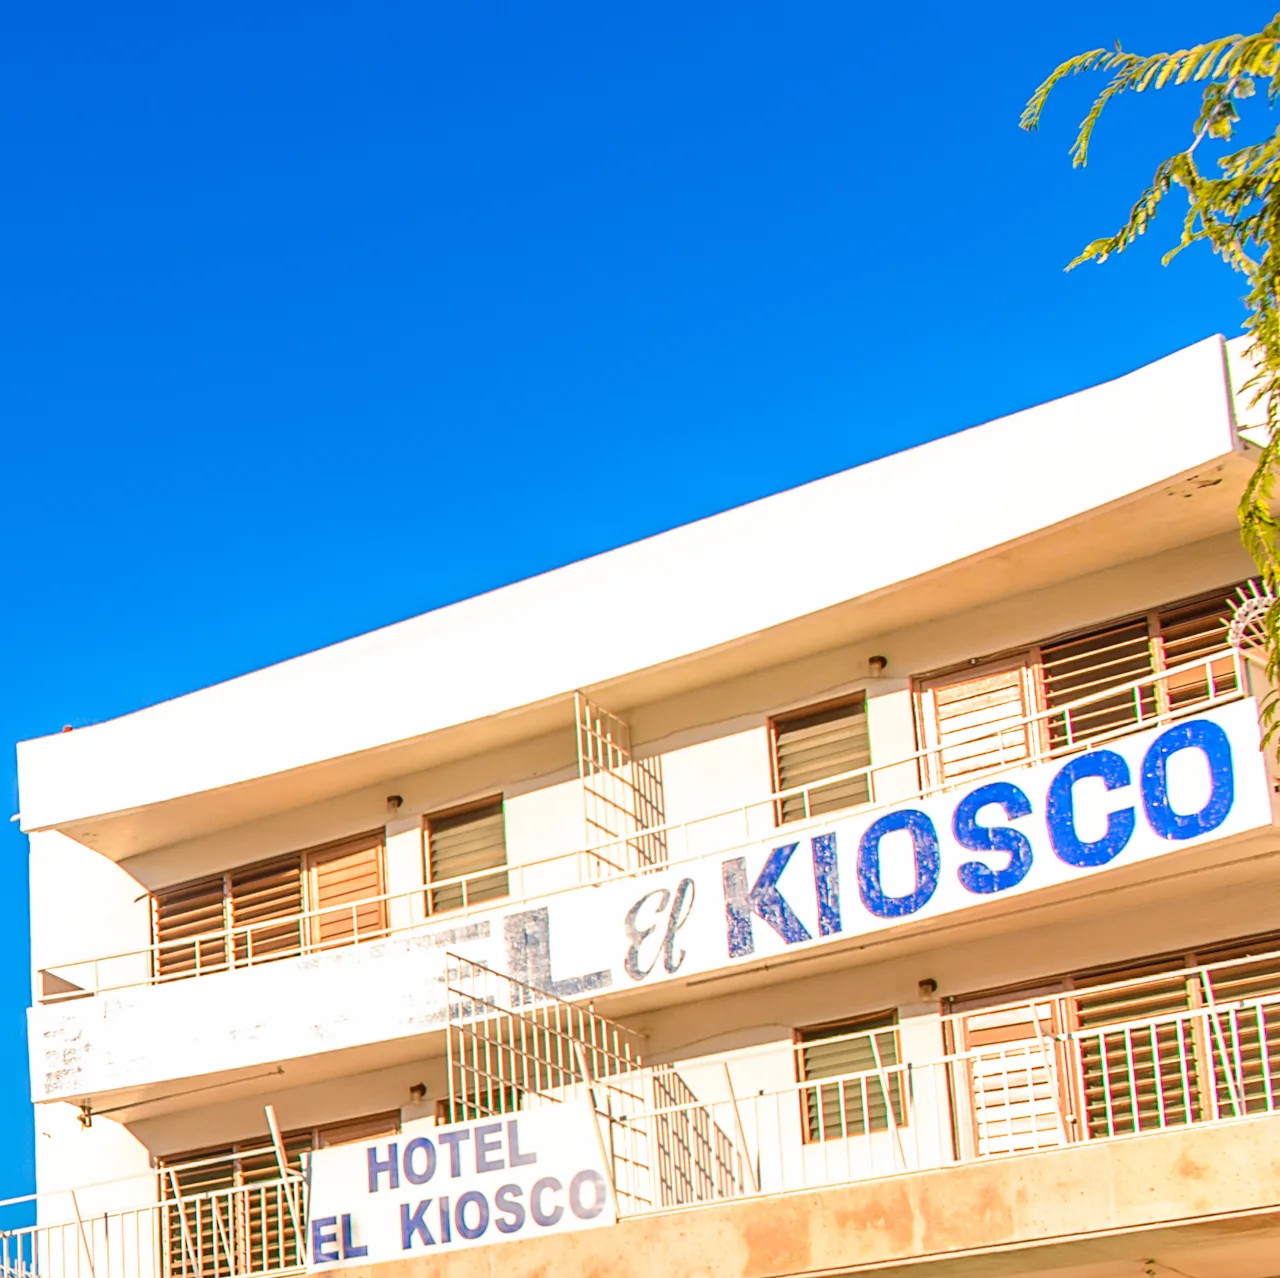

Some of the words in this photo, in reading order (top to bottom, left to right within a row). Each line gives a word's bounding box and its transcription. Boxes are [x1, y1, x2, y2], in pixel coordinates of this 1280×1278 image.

[624, 877, 695, 981] El
[721, 718, 1235, 959] KIOSCO
[367, 1119, 537, 1193] HOTEL
[312, 1213, 368, 1264] EL
[400, 1169, 606, 1250] KIOSCO
